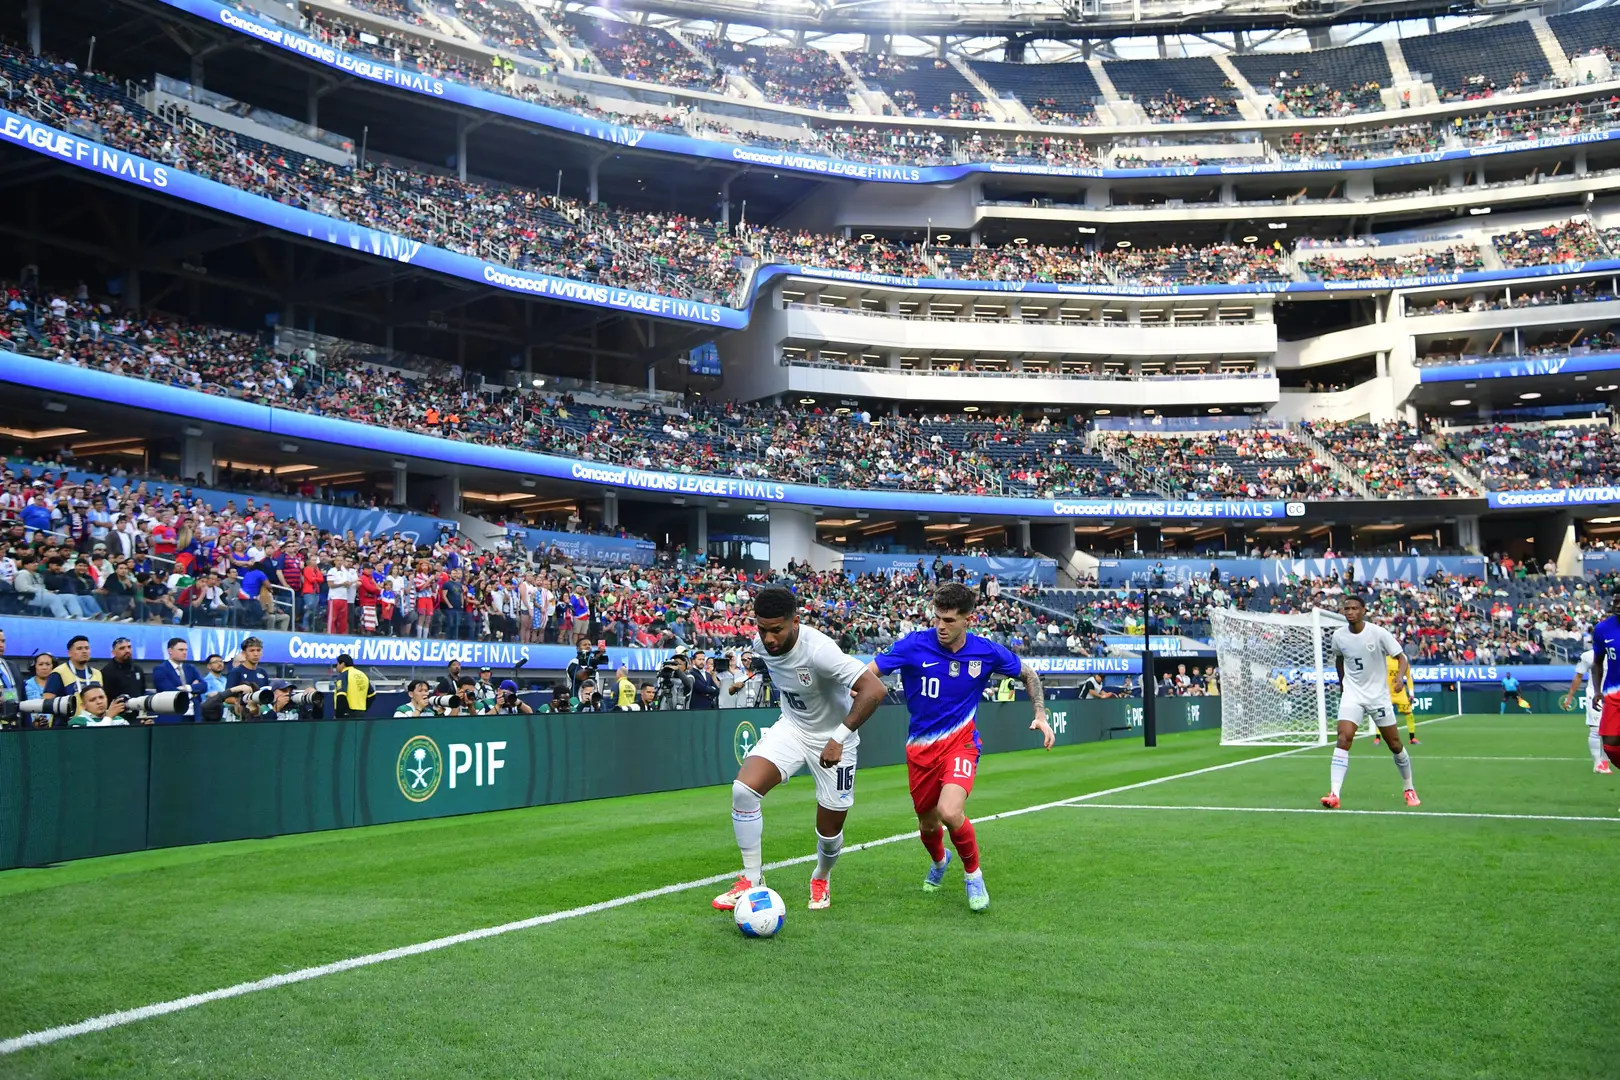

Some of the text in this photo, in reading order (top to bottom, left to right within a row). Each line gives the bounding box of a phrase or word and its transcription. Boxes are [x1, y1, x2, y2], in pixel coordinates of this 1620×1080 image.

[220, 9, 444, 95] Concacaf NATIONS LEAGUE FINALS
[1571, 132, 1609, 143] FINALS
[0, 117, 168, 187] EAGUE FINALS
[733, 148, 920, 181] Concacaf NATIONS LEAGUE FINALS
[1073, 168, 1103, 177] FINALS
[1309, 161, 1341, 169] FINALS
[887, 276, 918, 286] FINALS
[1421, 273, 1458, 284] FINALS
[484, 266, 720, 322] Concacaf NATIONS LEAGUE FINALS
[1145, 286, 1178, 294] FINALS
[572, 463, 785, 500] Concacaf NATIONS LEAGUE FINALS
[1497, 490, 1565, 505] Concacaf
[1053, 502, 1273, 516] Concacaf NATIONS LEAGUE FINALS
[1288, 505, 1303, 514] CC
[289, 636, 529, 664] Concacaf NATIONS LEAGUE FINALS
[1051, 658, 1085, 672] LEAGUE
[1086, 658, 1129, 671] FINALS
[1354, 657, 1363, 670] 5
[1441, 667, 1497, 679] FINALS
[920, 676, 939, 698] 10
[783, 690, 807, 710] 16
[1411, 697, 1432, 710] PIF
[1132, 707, 1143, 726] PIF
[1191, 704, 1200, 722] PIF
[1378, 707, 1386, 718] 5
[1053, 711, 1067, 734] PIF
[448, 741, 507, 789] PIF
[953, 757, 972, 777] 10
[836, 765, 854, 790] 16
